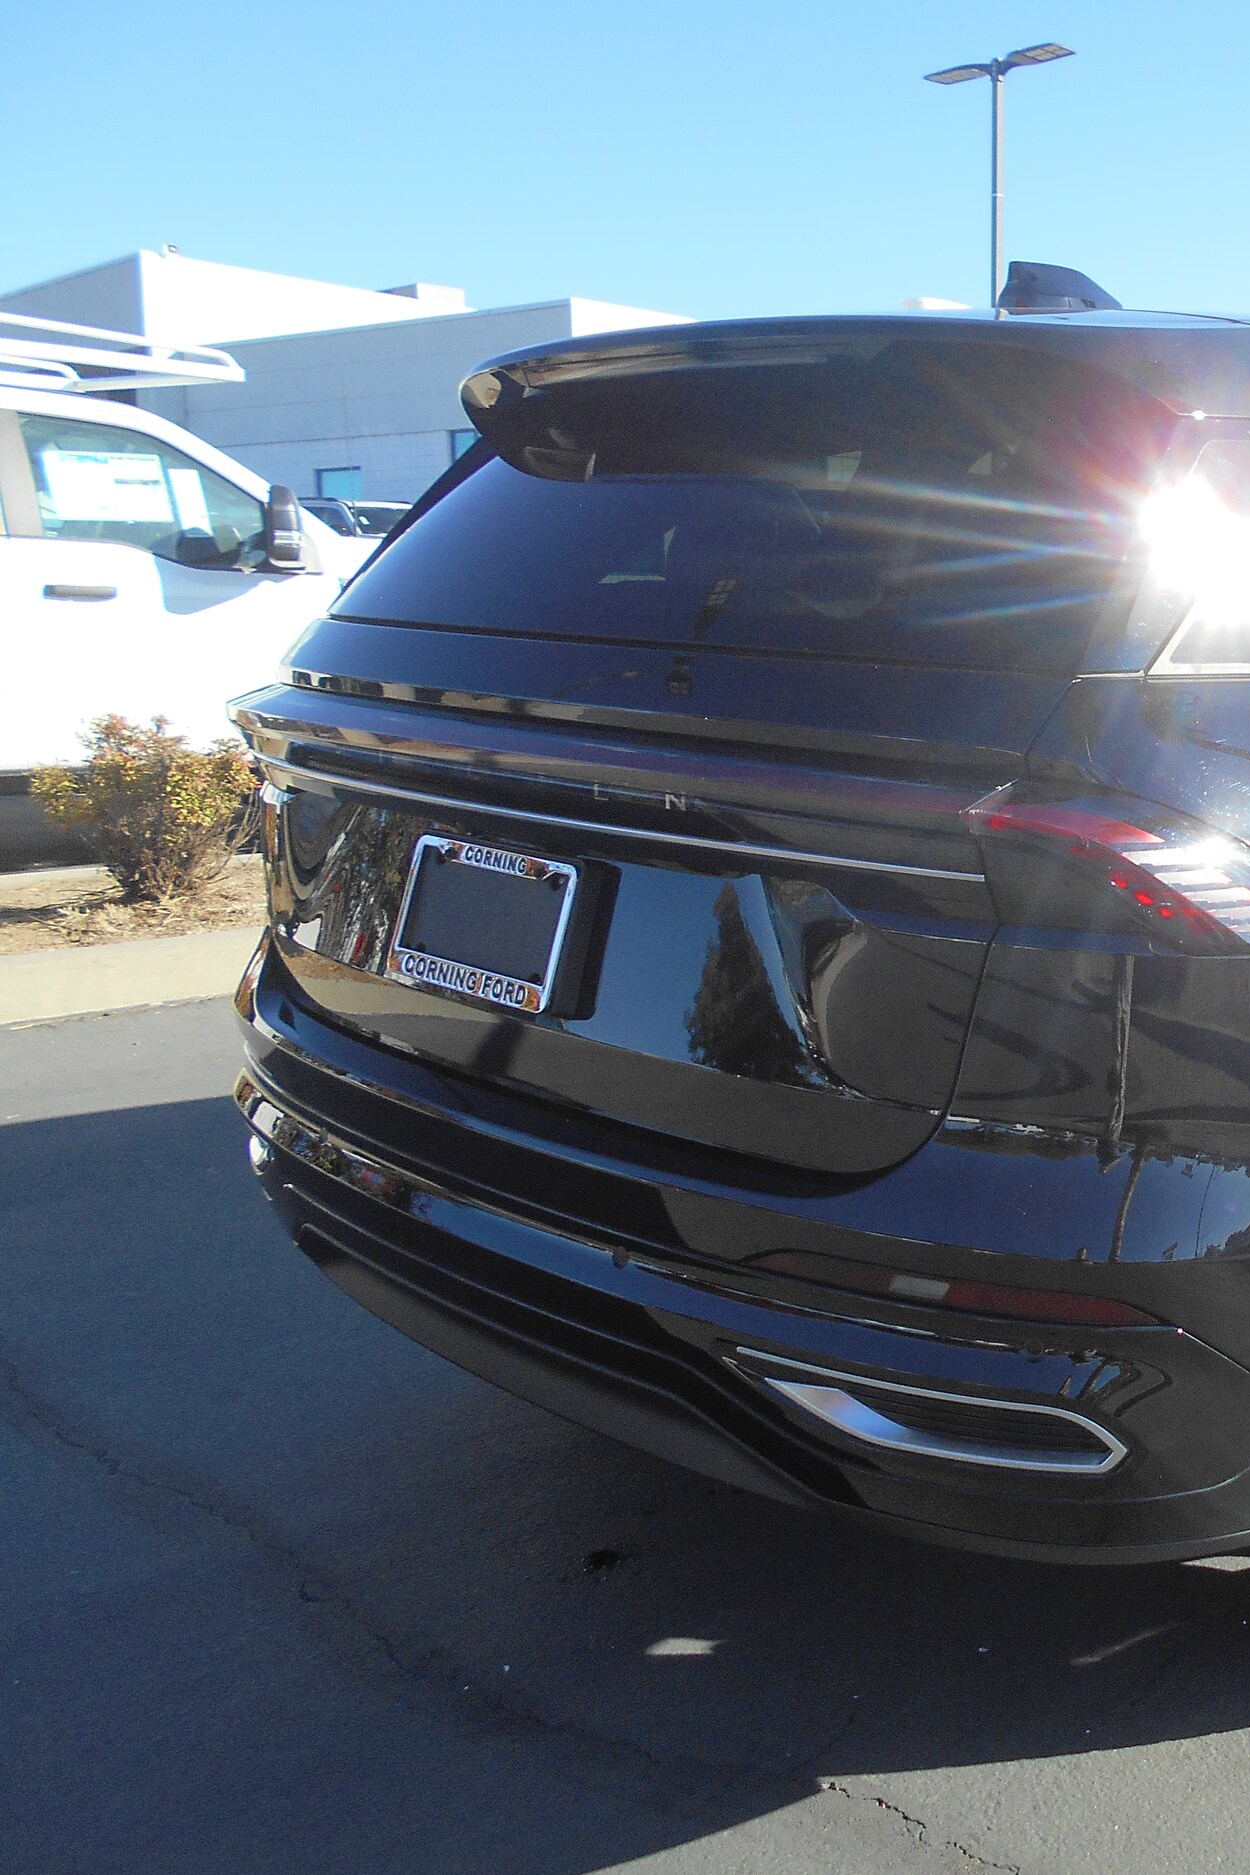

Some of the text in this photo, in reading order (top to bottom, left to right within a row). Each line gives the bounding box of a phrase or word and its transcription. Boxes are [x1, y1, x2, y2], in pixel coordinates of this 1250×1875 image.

[463, 845, 527, 874] CORNING
[404, 954, 526, 1006] CORNING FORD
